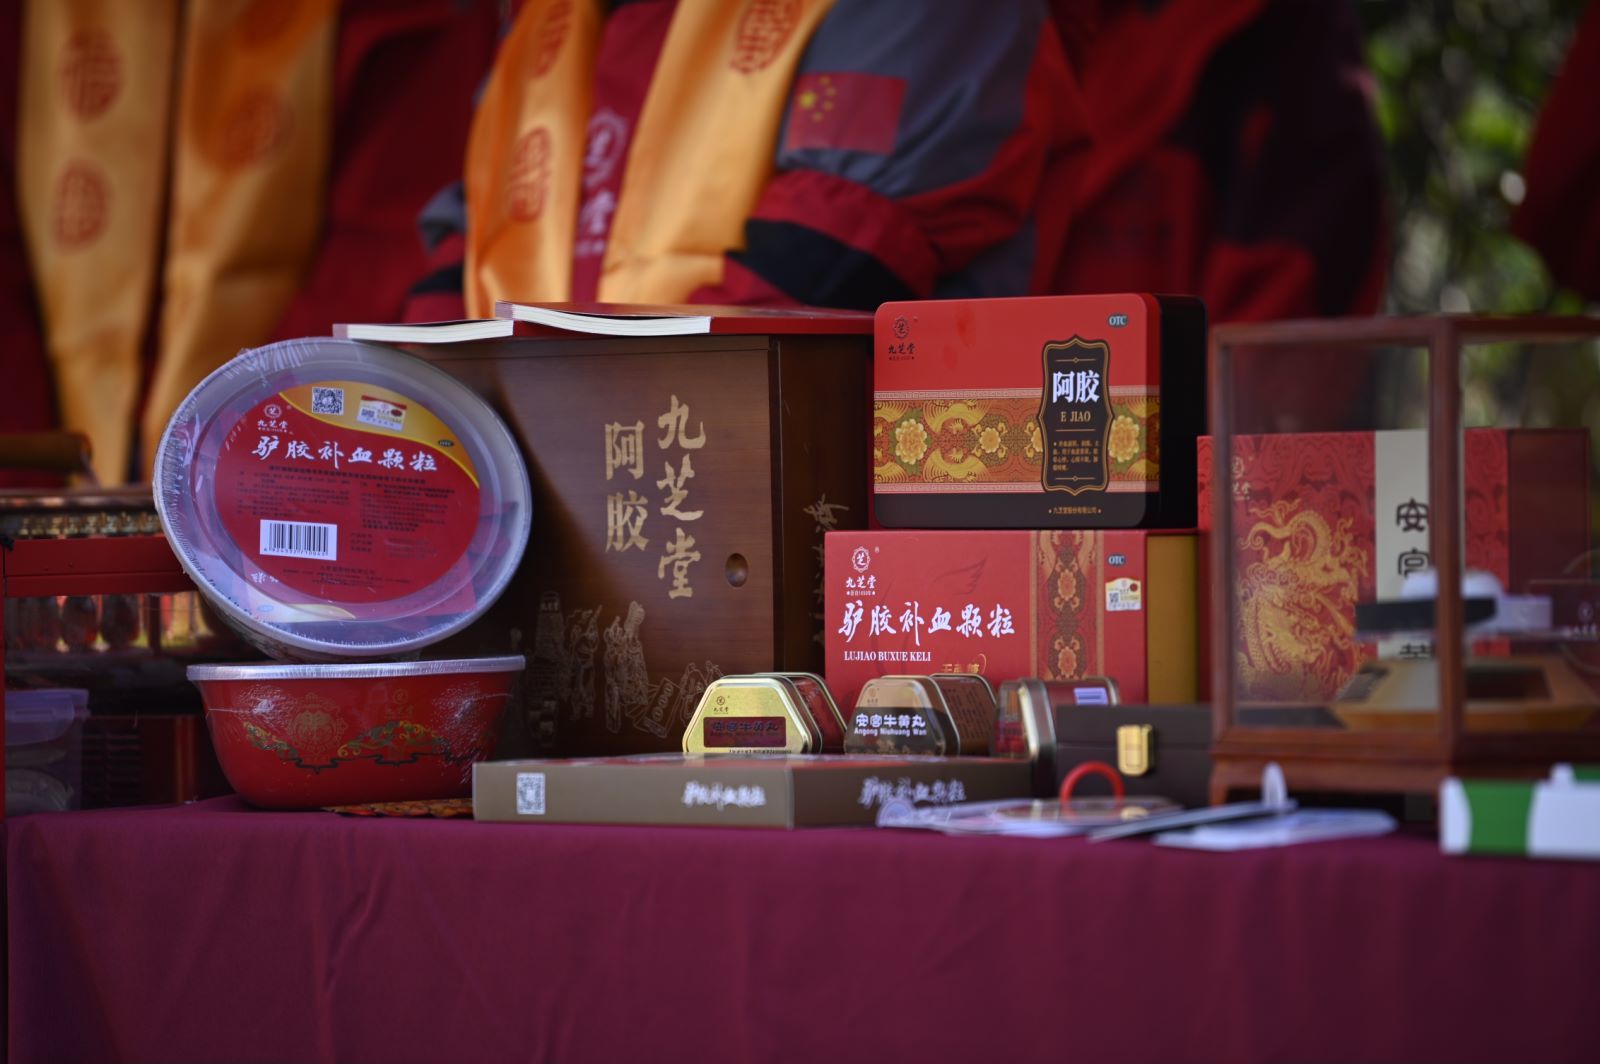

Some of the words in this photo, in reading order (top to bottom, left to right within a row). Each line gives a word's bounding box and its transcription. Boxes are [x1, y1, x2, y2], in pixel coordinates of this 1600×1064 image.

[1109, 316, 1127, 326] OTC
[888, 343, 915, 354] 九芝堂
[1052, 370, 1100, 403] 阿胶
[1060, 411, 1067, 422] E
[1070, 411, 1091, 422] JIAO
[257, 419, 289, 429] 九芝堂
[252, 435, 437, 473] 驴胶补血颗粒
[604, 420, 649, 552] 阿胶
[656, 394, 706, 599] 九芝堂
[1108, 555, 1125, 565] OTC
[845, 575, 877, 589] 九芝堂
[838, 600, 1015, 646] 驴胶补血颗粒
[844, 651, 876, 662] LUJIAO
[878, 651, 908, 662] BUXUE
[910, 651, 931, 662] KELI
[855, 713, 926, 728] 安宫牛黄丸
[854, 728, 878, 737] Angong
